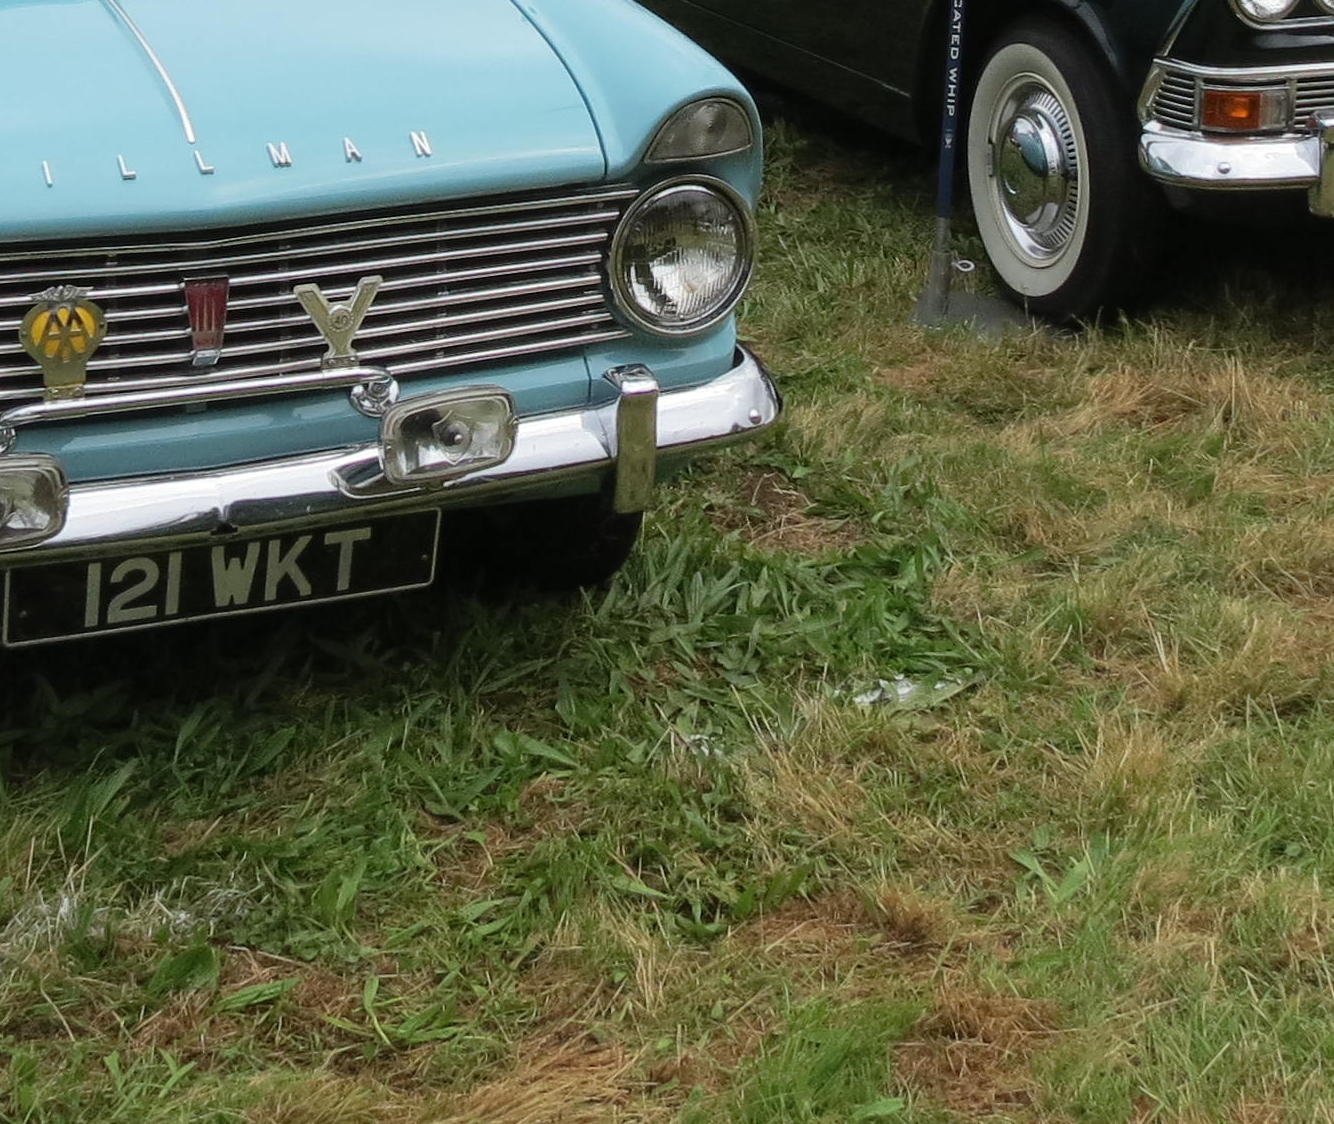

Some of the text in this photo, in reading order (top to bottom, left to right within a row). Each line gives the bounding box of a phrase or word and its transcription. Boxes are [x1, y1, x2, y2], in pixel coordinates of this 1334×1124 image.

[947, 68, 958, 117] WHIP
[83, 527, 371, 628] 121 WKT
